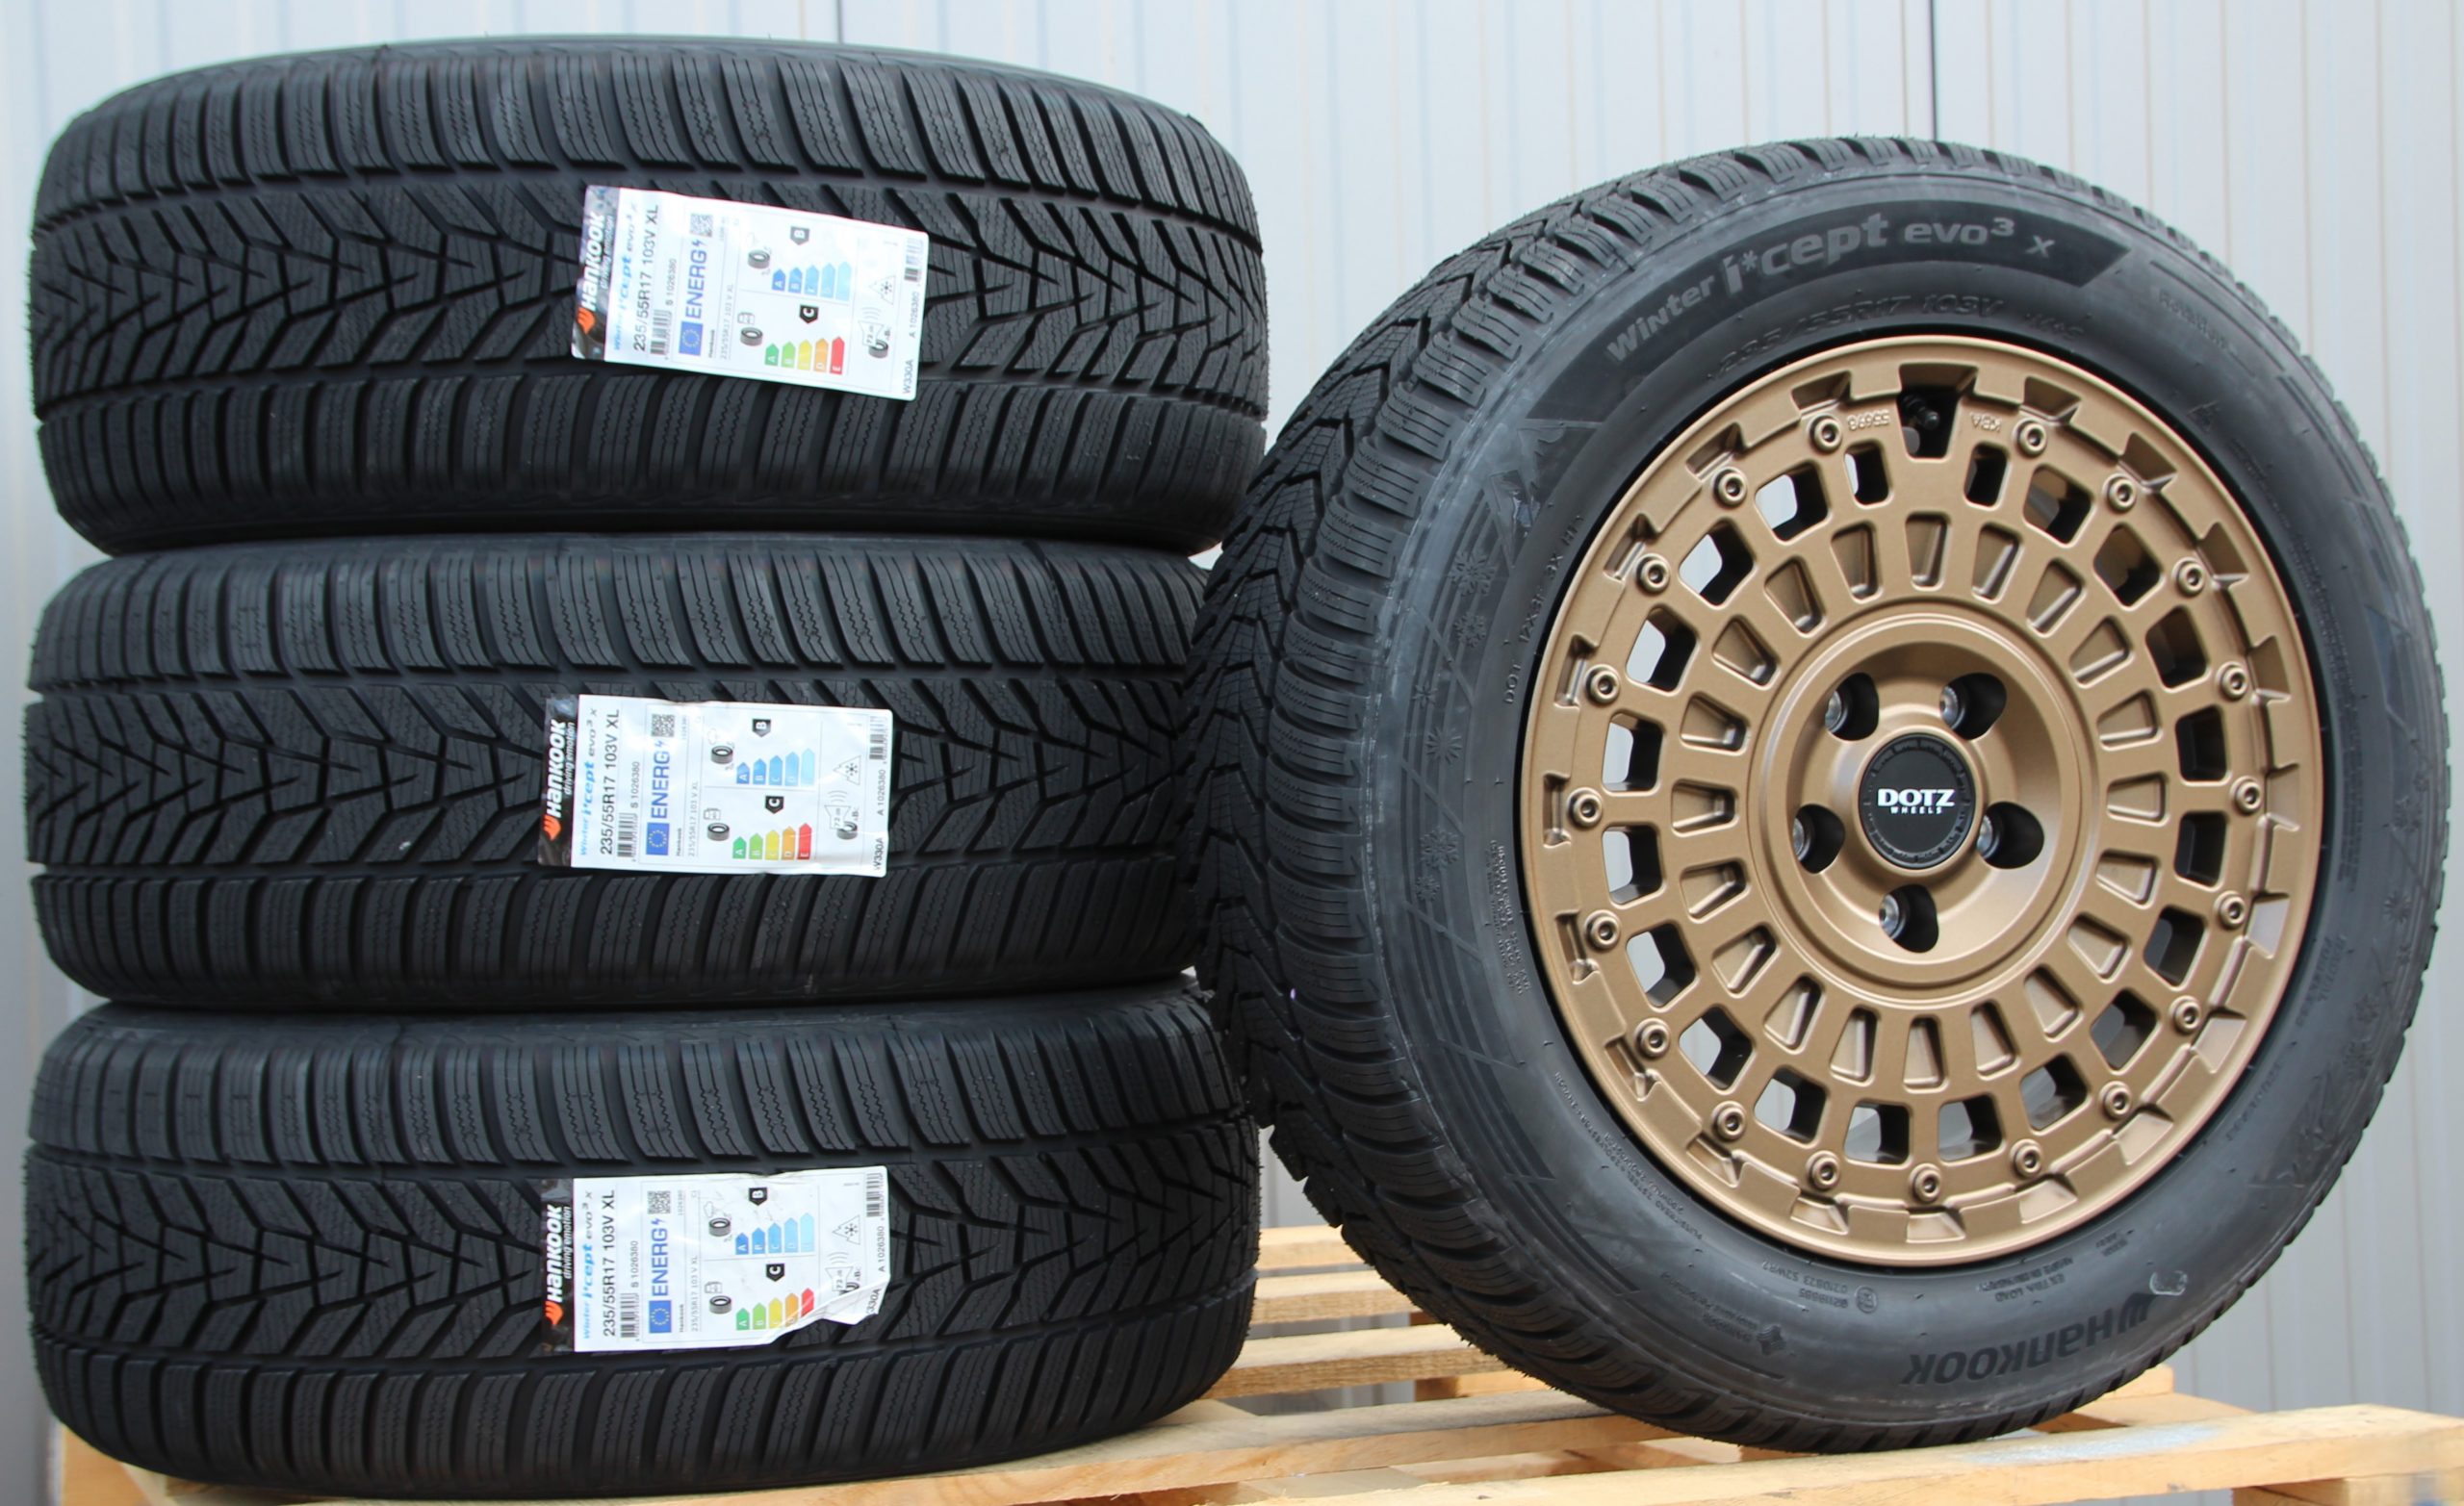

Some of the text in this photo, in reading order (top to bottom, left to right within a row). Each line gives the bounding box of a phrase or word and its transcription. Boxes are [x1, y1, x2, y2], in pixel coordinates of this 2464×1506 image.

[794, 229, 806, 239] B
[580, 212, 605, 312] Hankook
[633, 205, 659, 352] 235/55R17 103V XL
[803, 307, 815, 317] C
[1606, 274, 1715, 364] Winter
[1921, 293, 2005, 317] 103V
[903, 359, 913, 394] W330A
[756, 722, 767, 730] B
[547, 720, 566, 818] Hankook
[563, 722, 576, 795] driving emotion
[601, 709, 620, 855] 235/55R17 103V XL
[631, 761, 641, 799] 1026380
[878, 769, 886, 806] 1026380
[1877, 788, 1956, 806] DOTZ
[769, 798, 781, 806] C
[873, 837, 885, 870] W330A
[752, 1189, 764, 1198] B
[547, 1205, 563, 1303] Hankook
[562, 1207, 573, 1279] driving emotion
[630, 1240, 639, 1280] 1026380
[877, 1225, 886, 1264] 1026380
[602, 1190, 616, 1337] 235/55R17 103V XL
[769, 1265, 781, 1274] C
[868, 1288, 882, 1315] 330A
[1898, 1308, 2115, 1386] Hankook
